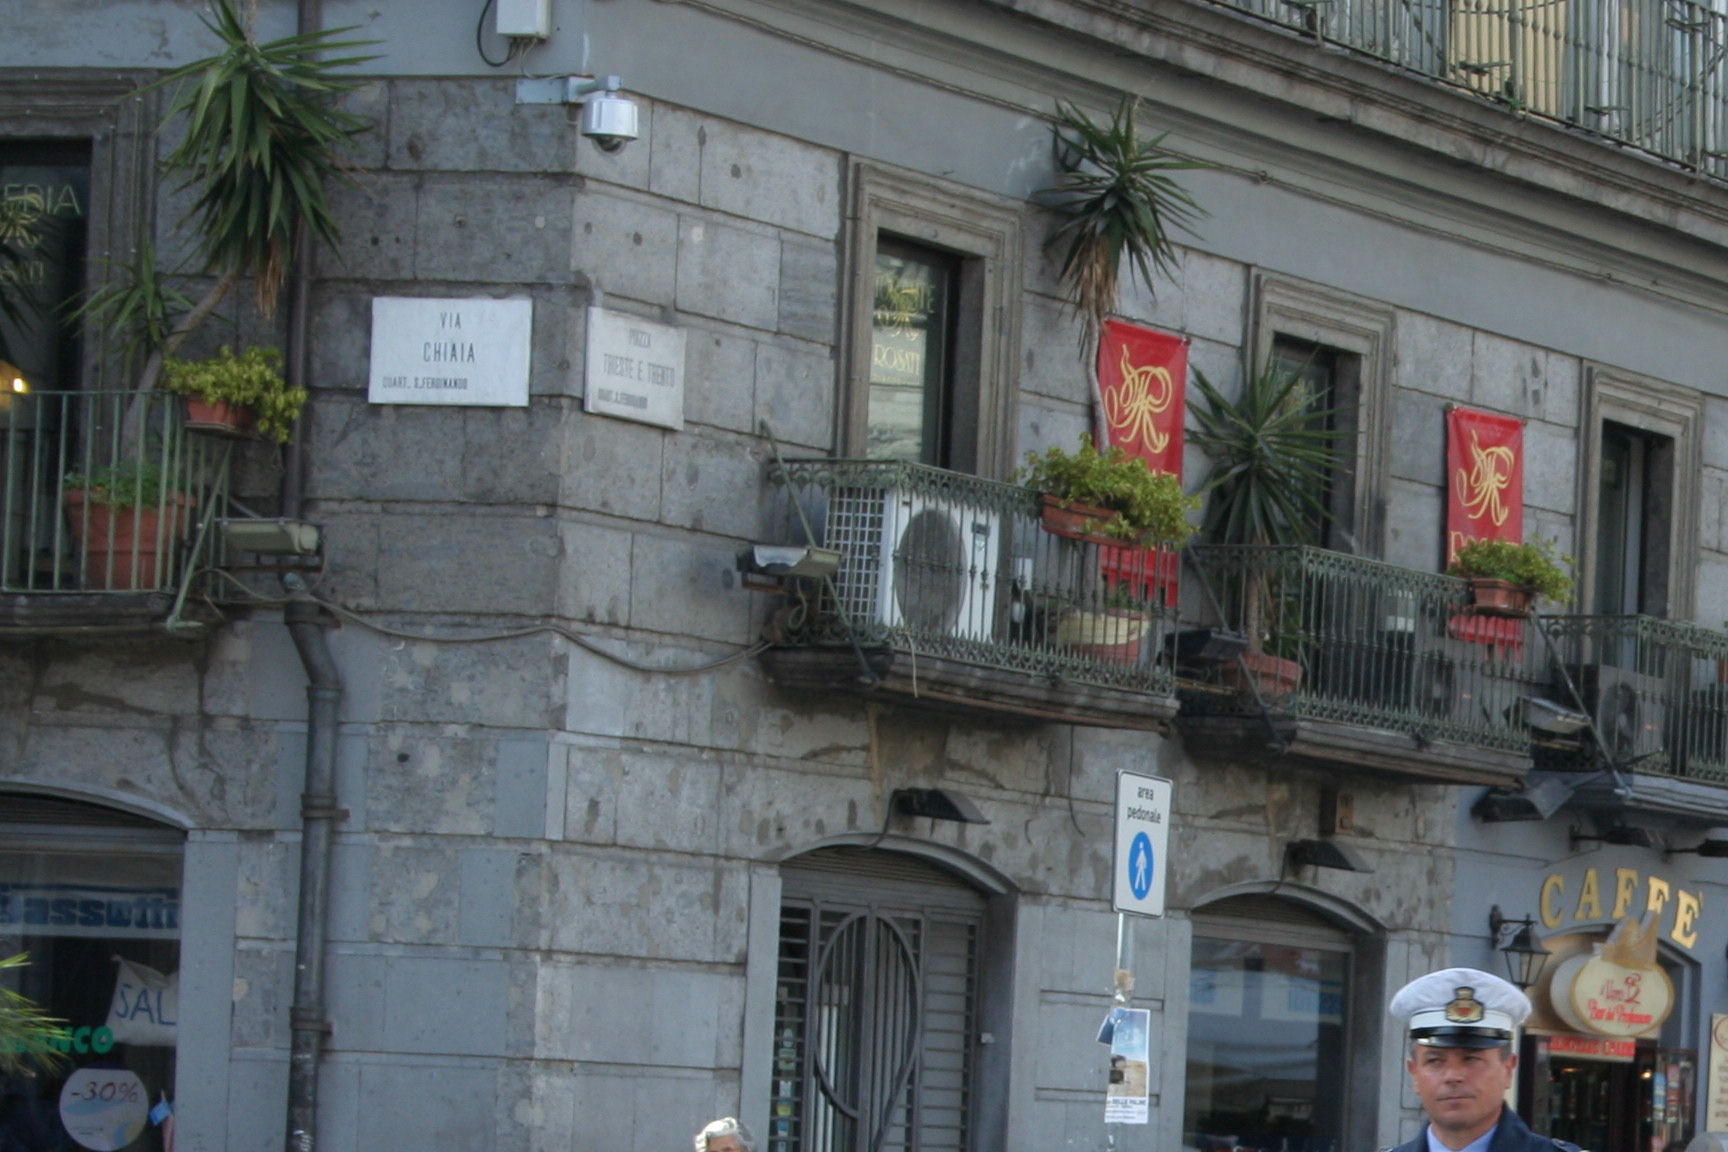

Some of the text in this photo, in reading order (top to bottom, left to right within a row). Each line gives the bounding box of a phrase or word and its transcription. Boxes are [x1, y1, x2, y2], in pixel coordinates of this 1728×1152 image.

[440, 312, 462, 329] VIA
[423, 342, 476, 363] CHIAIA
[1137, 786, 1154, 800] area
[1127, 805, 1161, 824] pedonale
